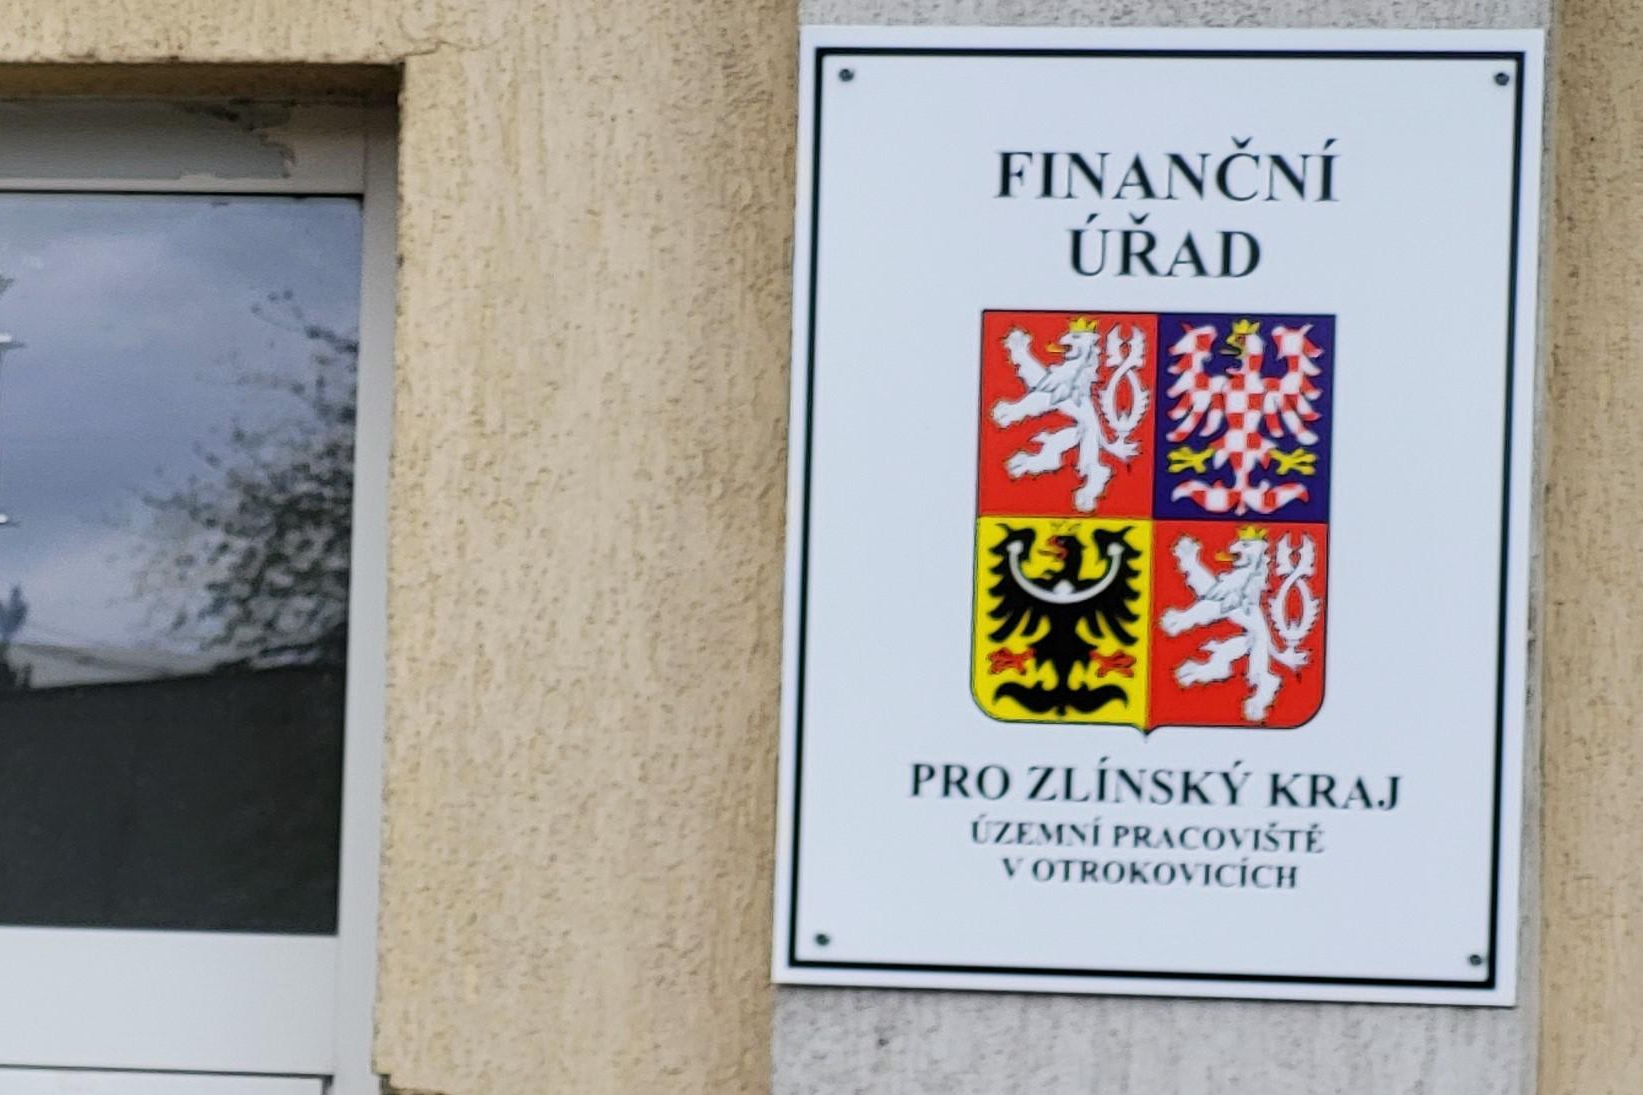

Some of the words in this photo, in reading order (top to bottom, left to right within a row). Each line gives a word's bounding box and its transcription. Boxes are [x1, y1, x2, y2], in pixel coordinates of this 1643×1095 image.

[994, 136, 1341, 204] FINANČNÍ
[1067, 212, 1264, 280] ÚŘAD
[910, 762, 1014, 802] PRO
[1026, 756, 1254, 808] ZLÍNSKÝ
[1268, 772, 1403, 813] KRAJ
[971, 814, 1103, 849] ÚZEMNÍ
[1113, 822, 1326, 855] PRACOVIŠTĚ
[1001, 857, 1025, 880] V
[1031, 857, 1300, 890] OTROKOVICÍCH
